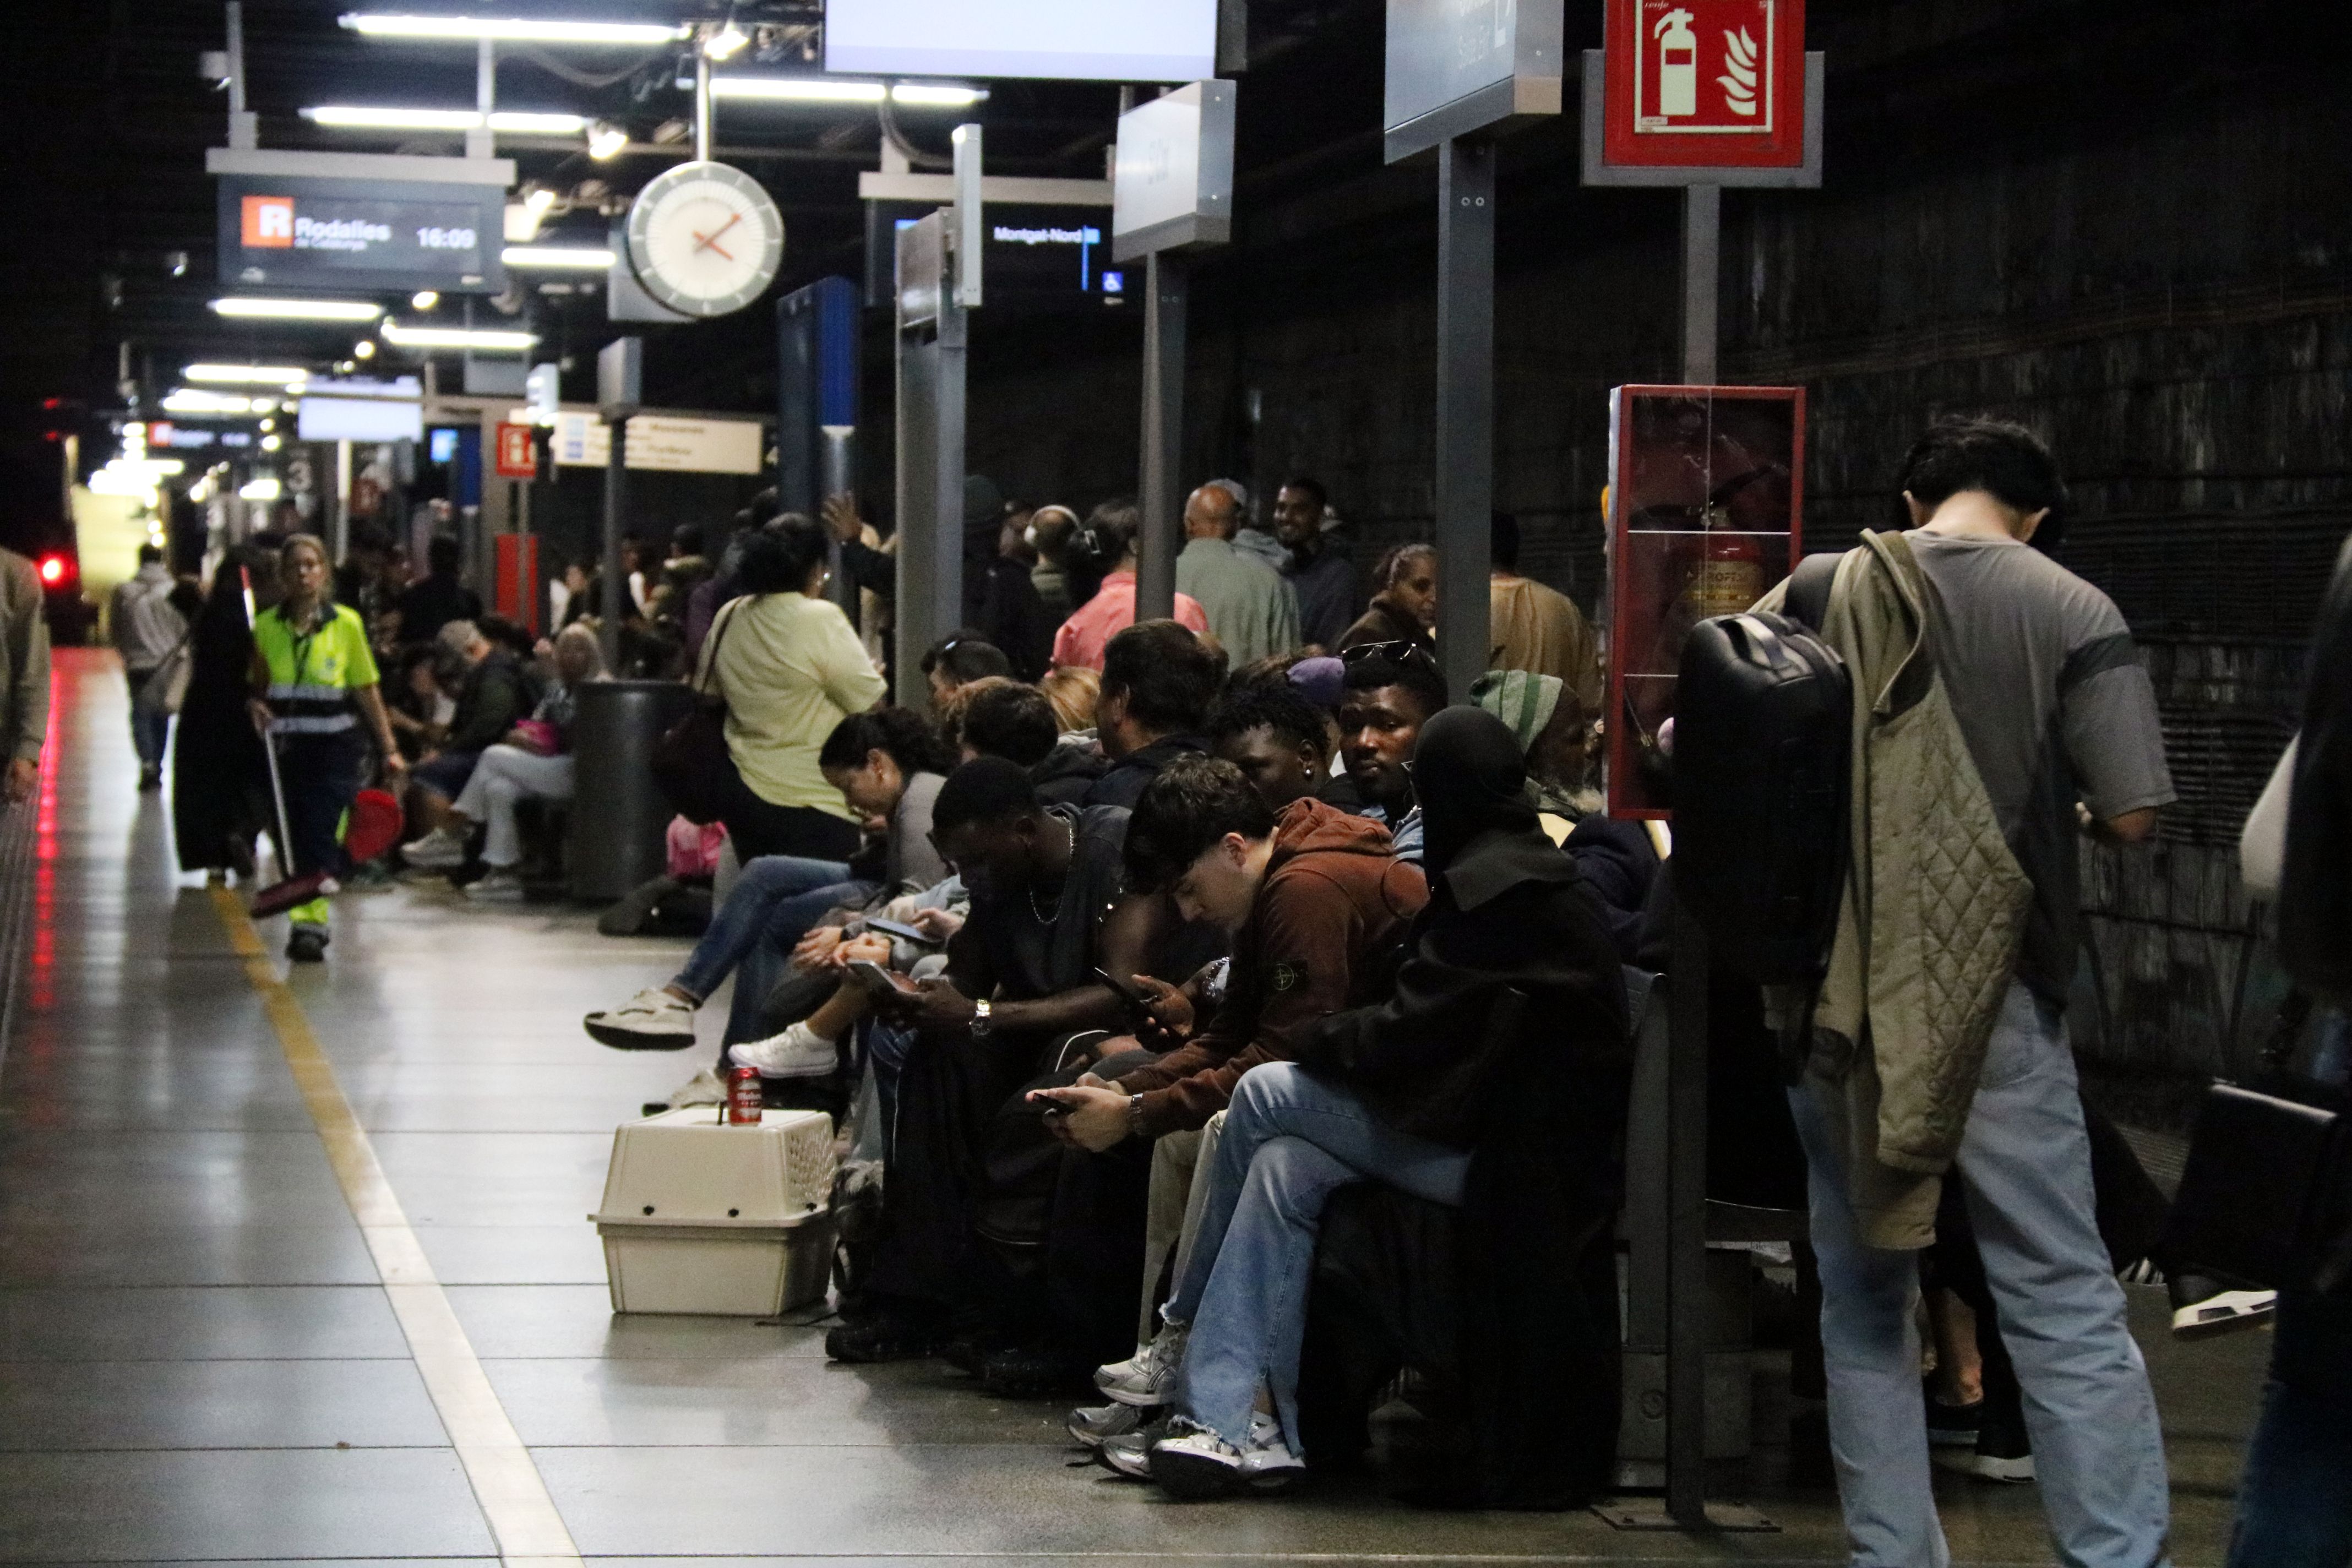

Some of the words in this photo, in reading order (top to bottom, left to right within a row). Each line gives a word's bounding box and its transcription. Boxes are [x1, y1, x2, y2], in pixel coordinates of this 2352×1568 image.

[259, 204, 293, 237] R
[295, 217, 391, 241] Rodalies
[416, 227, 476, 249] 16:09
